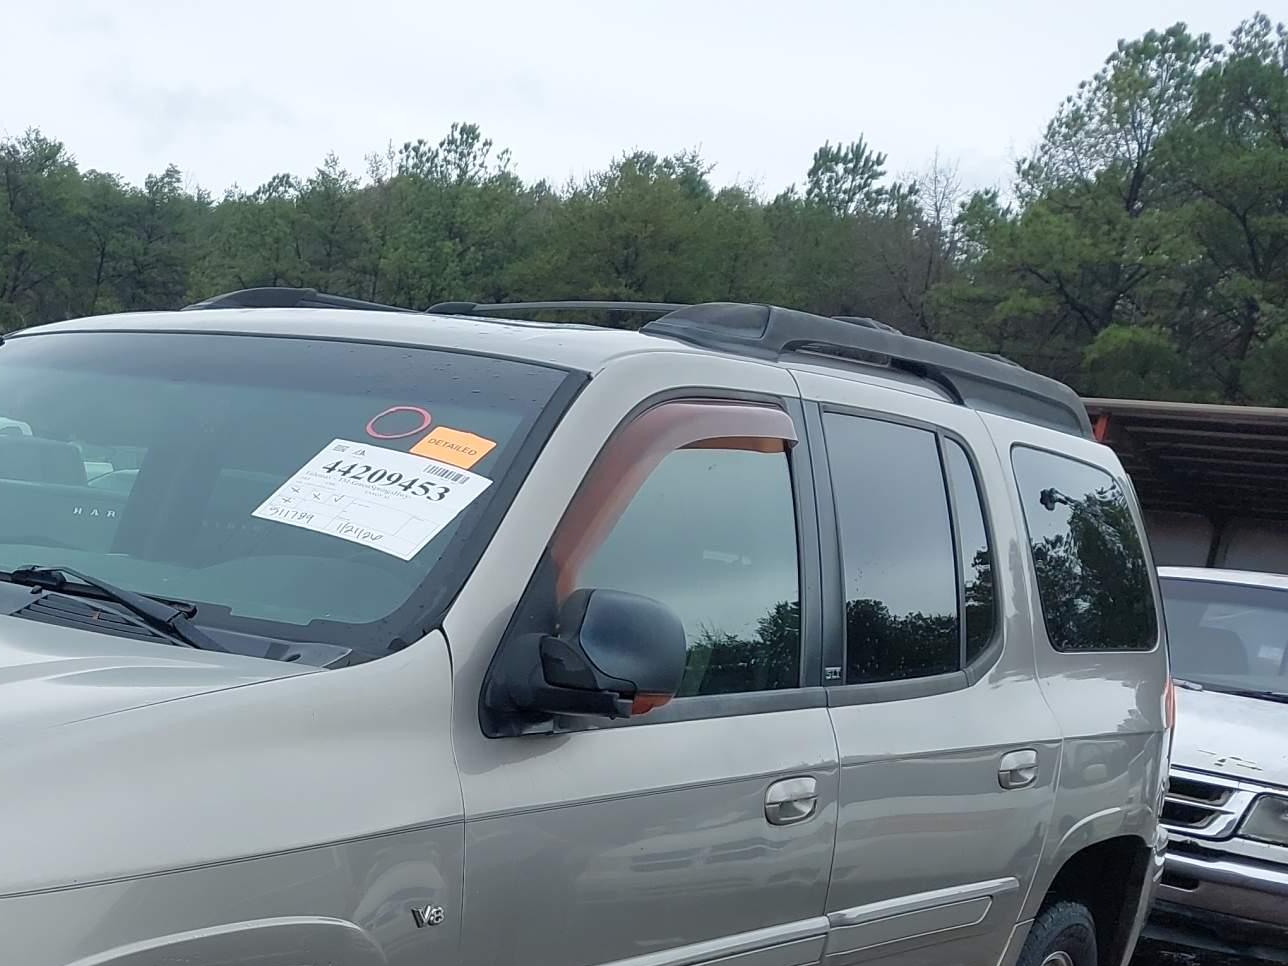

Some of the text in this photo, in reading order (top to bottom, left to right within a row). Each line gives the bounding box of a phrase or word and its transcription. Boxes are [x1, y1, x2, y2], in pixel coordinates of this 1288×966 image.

[427, 437, 477, 457] DETAILED
[321, 460, 452, 503] 44209453
[412, 905, 445, 928] V8
